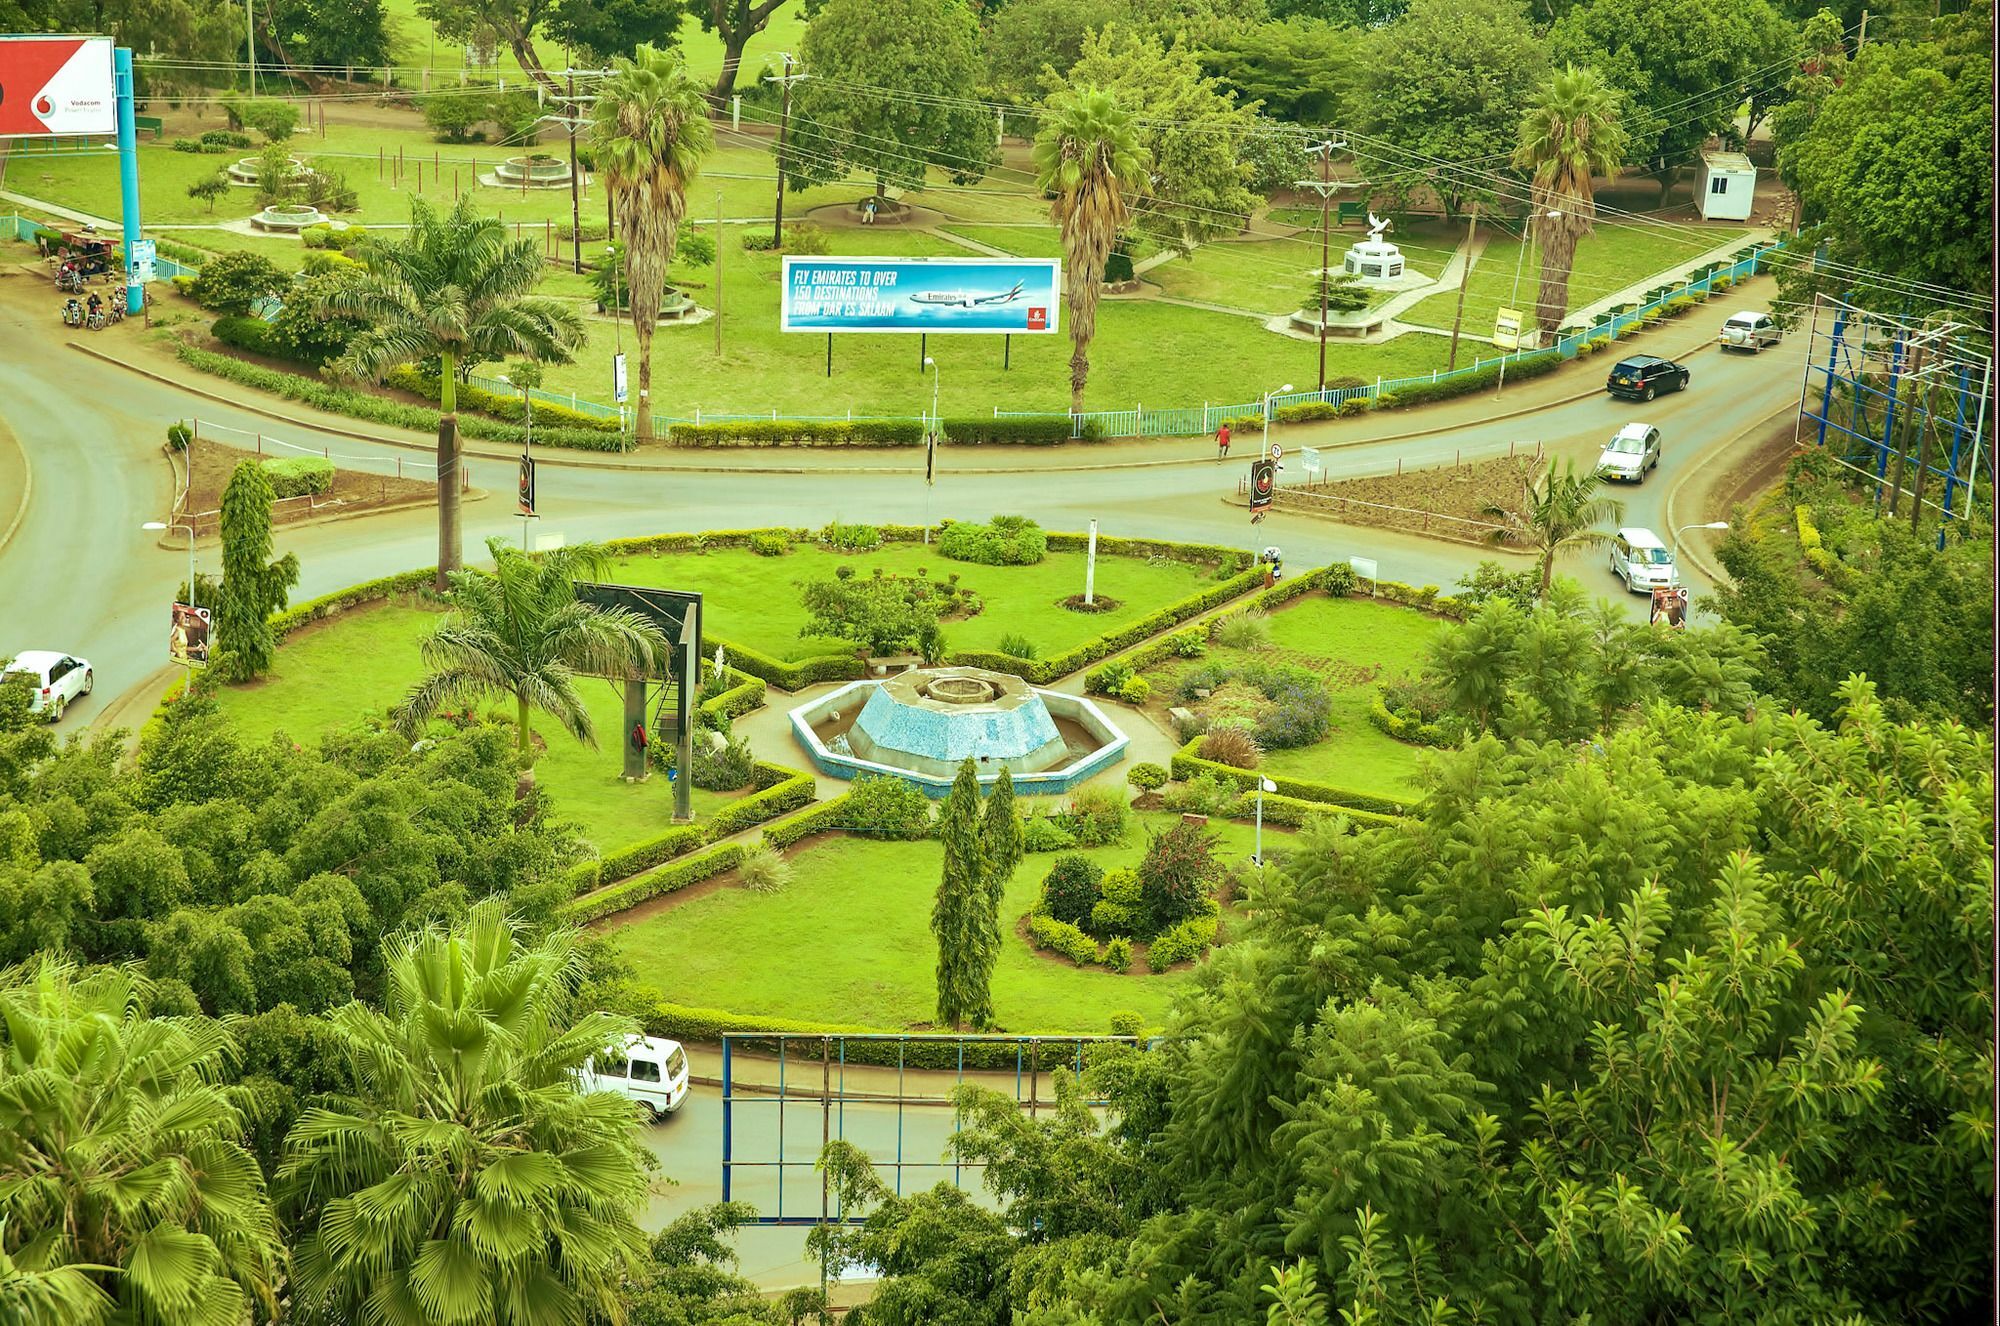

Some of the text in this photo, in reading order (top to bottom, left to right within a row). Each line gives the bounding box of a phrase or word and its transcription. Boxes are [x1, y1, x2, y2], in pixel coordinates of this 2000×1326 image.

[794, 269, 897, 286] FLY EMIRATES TO OVER
[794, 285, 879, 300] 150 DESTINATIONS
[928, 292, 957, 301] Emirates
[793, 300, 896, 316] FROM DAR ES SALAAM
